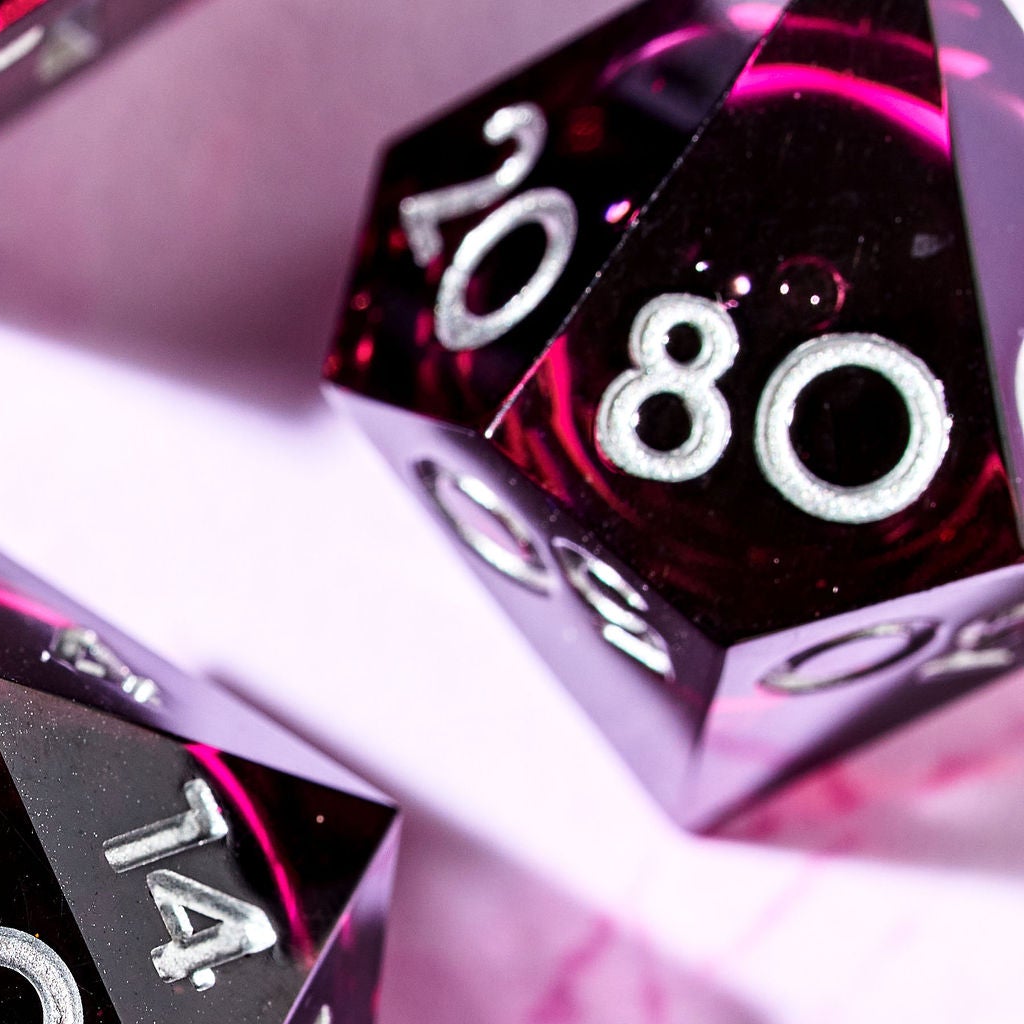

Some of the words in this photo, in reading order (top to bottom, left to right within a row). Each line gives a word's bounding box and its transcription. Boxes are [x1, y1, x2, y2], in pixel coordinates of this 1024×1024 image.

[397, 102, 578, 351] 20
[595, 292, 953, 525] 80
[102, 778, 277, 991] 14
